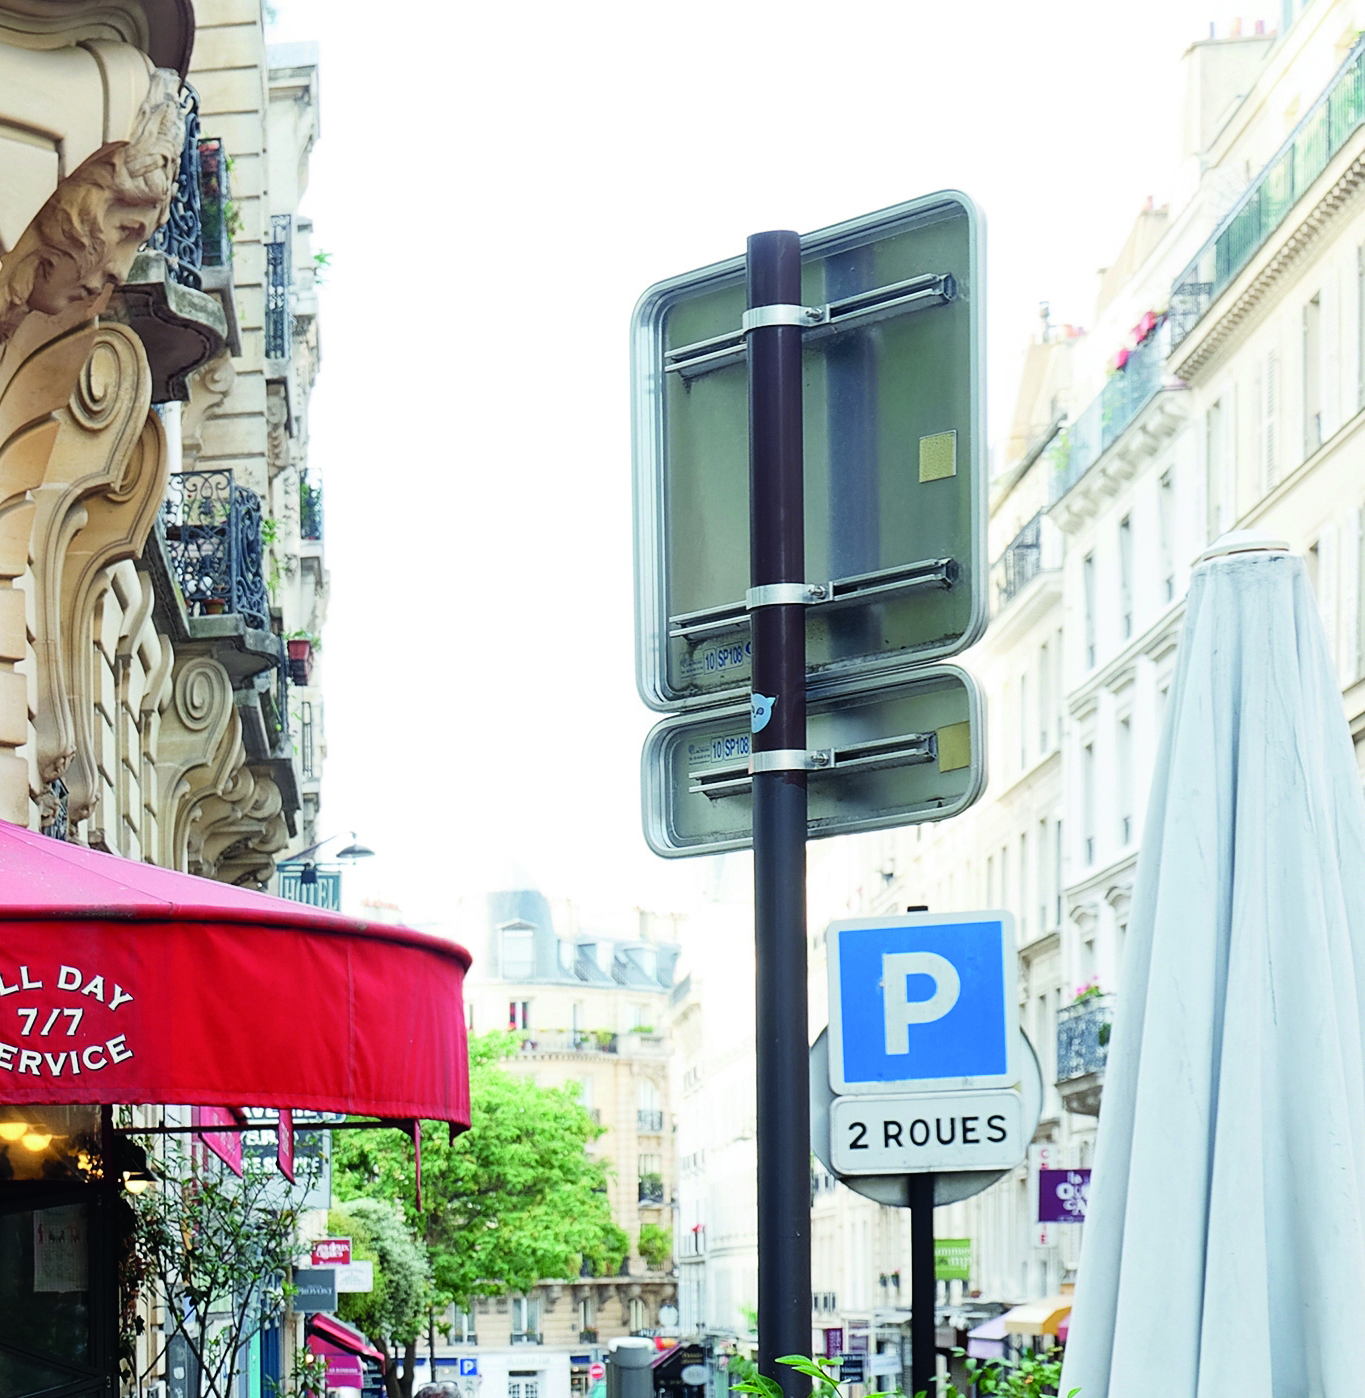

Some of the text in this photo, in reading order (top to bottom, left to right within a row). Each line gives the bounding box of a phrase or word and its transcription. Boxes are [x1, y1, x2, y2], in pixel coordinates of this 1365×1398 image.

[705, 652, 715, 671] 10
[718, 645, 743, 667] SP108
[712, 741, 722, 759] 10
[725, 736, 749, 758] SP108
[57, 964, 135, 1011] DAY
[882, 951, 961, 1056] P
[17, 1006, 84, 1037] 7/7
[848, 1115, 1007, 1149] 2 ROUES
